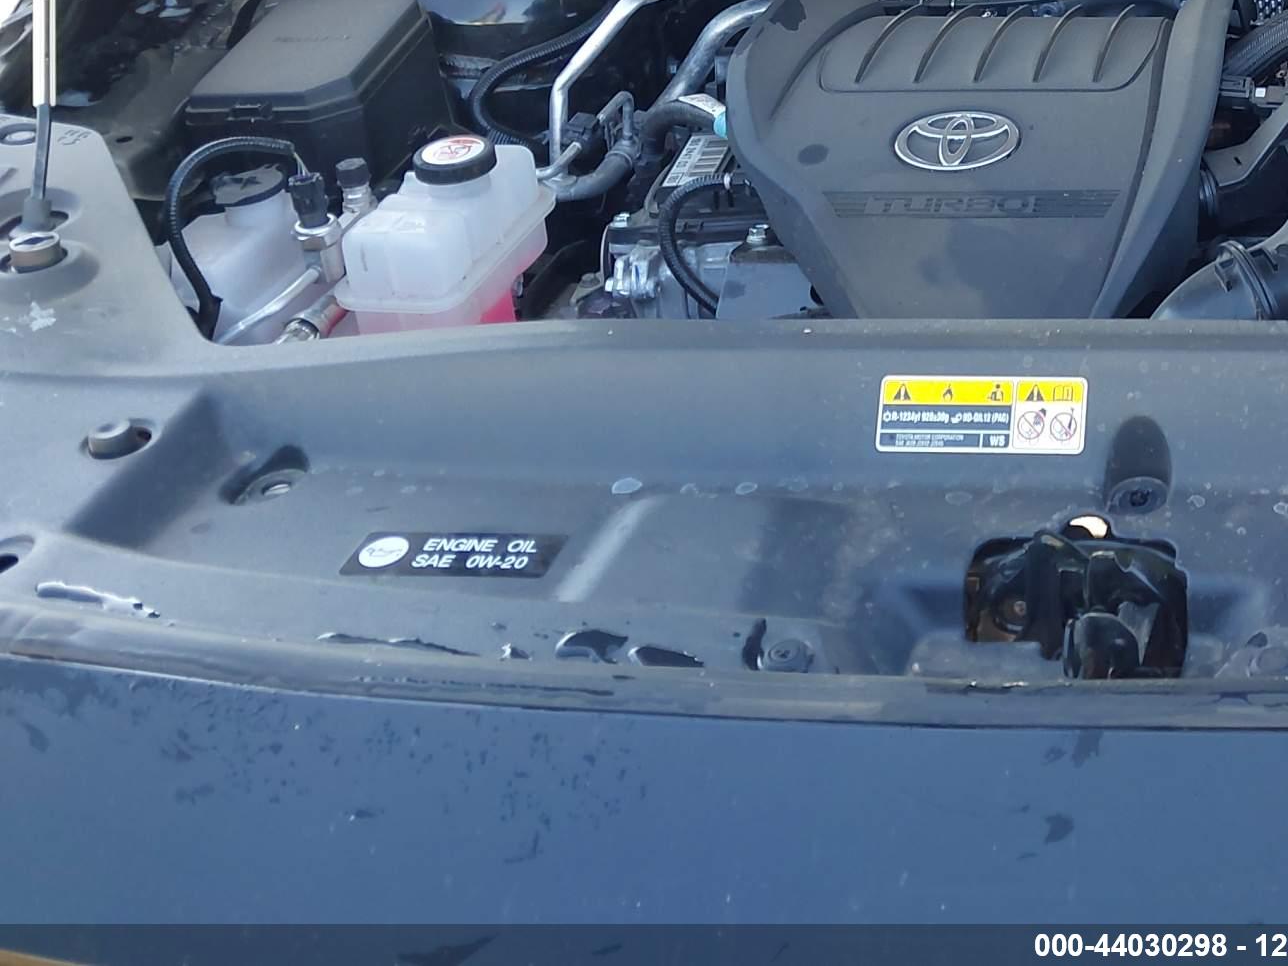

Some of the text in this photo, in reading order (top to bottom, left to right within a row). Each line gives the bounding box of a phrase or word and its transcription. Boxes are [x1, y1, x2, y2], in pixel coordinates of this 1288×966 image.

[869, 195, 1030, 214] TURBO
[422, 538, 538, 553] ENGINE OIL
[411, 553, 529, 570] SAE 0W-20
